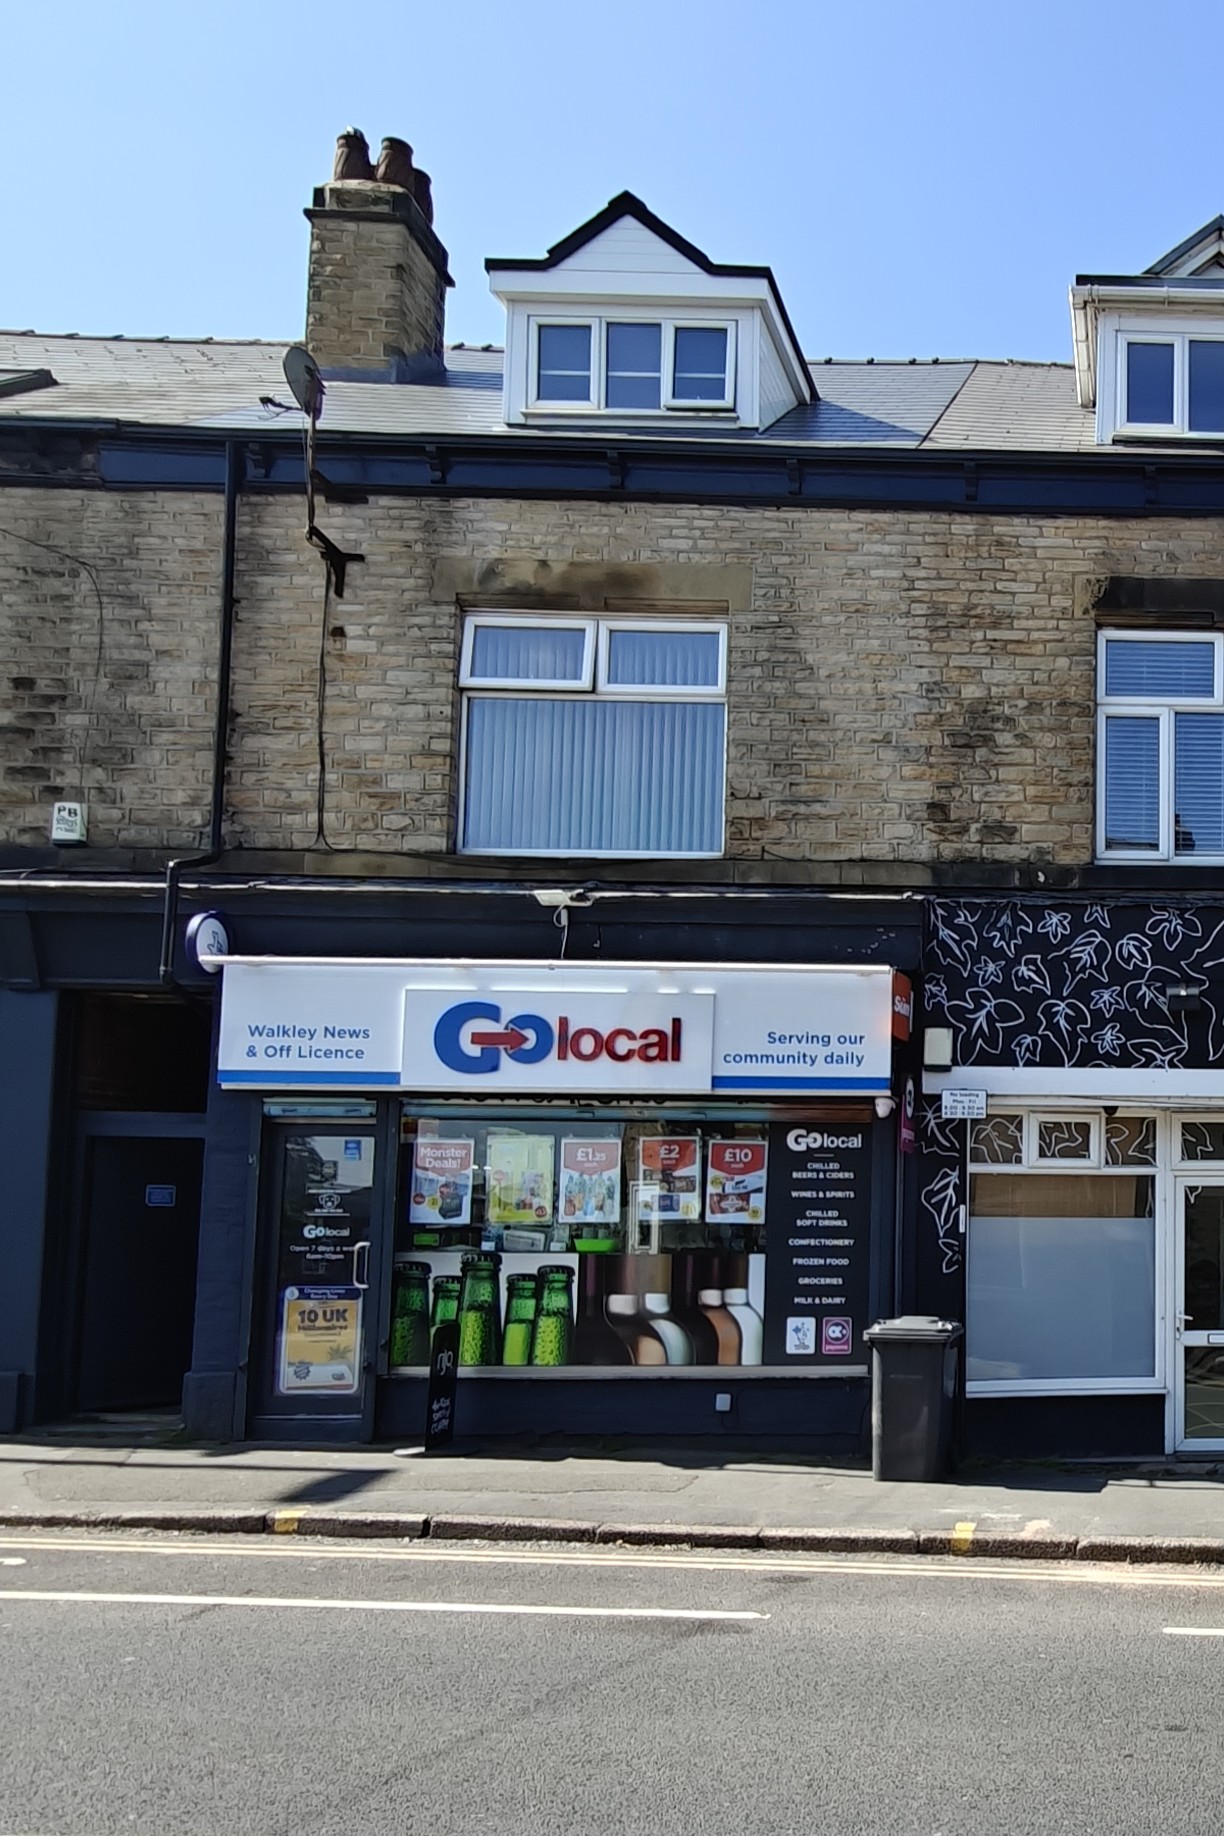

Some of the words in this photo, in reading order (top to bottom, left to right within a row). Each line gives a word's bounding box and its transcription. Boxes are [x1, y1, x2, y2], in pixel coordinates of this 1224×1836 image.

[247, 1024, 318, 1042] Walkley
[323, 1025, 371, 1040] News
[557, 1015, 682, 1064] local
[767, 1031, 832, 1049] Serving
[836, 1034, 866, 1046] our
[245, 1044, 258, 1059] &
[263, 1044, 292, 1059] Off
[297, 1045, 366, 1060] Licence
[722, 1051, 819, 1068] community
[823, 1051, 865, 1067] daily
[823, 1132, 862, 1149] local
[420, 1147, 468, 1158] Monster
[659, 1144, 680, 1159] £2
[723, 1147, 753, 1162] £10
[425, 1157, 461, 1169] Deals!
[325, 1227, 350, 1237] local
[787, 1238, 855, 1246] CONFECTIONERY
[792, 1258, 825, 1266] FROZEN
[825, 1258, 850, 1266] FOOD
[798, 1277, 843, 1285] GROCERIES
[793, 1297, 813, 1305] MILK
[298, 1308, 319, 1324] 10
[322, 1308, 349, 1323] UK
